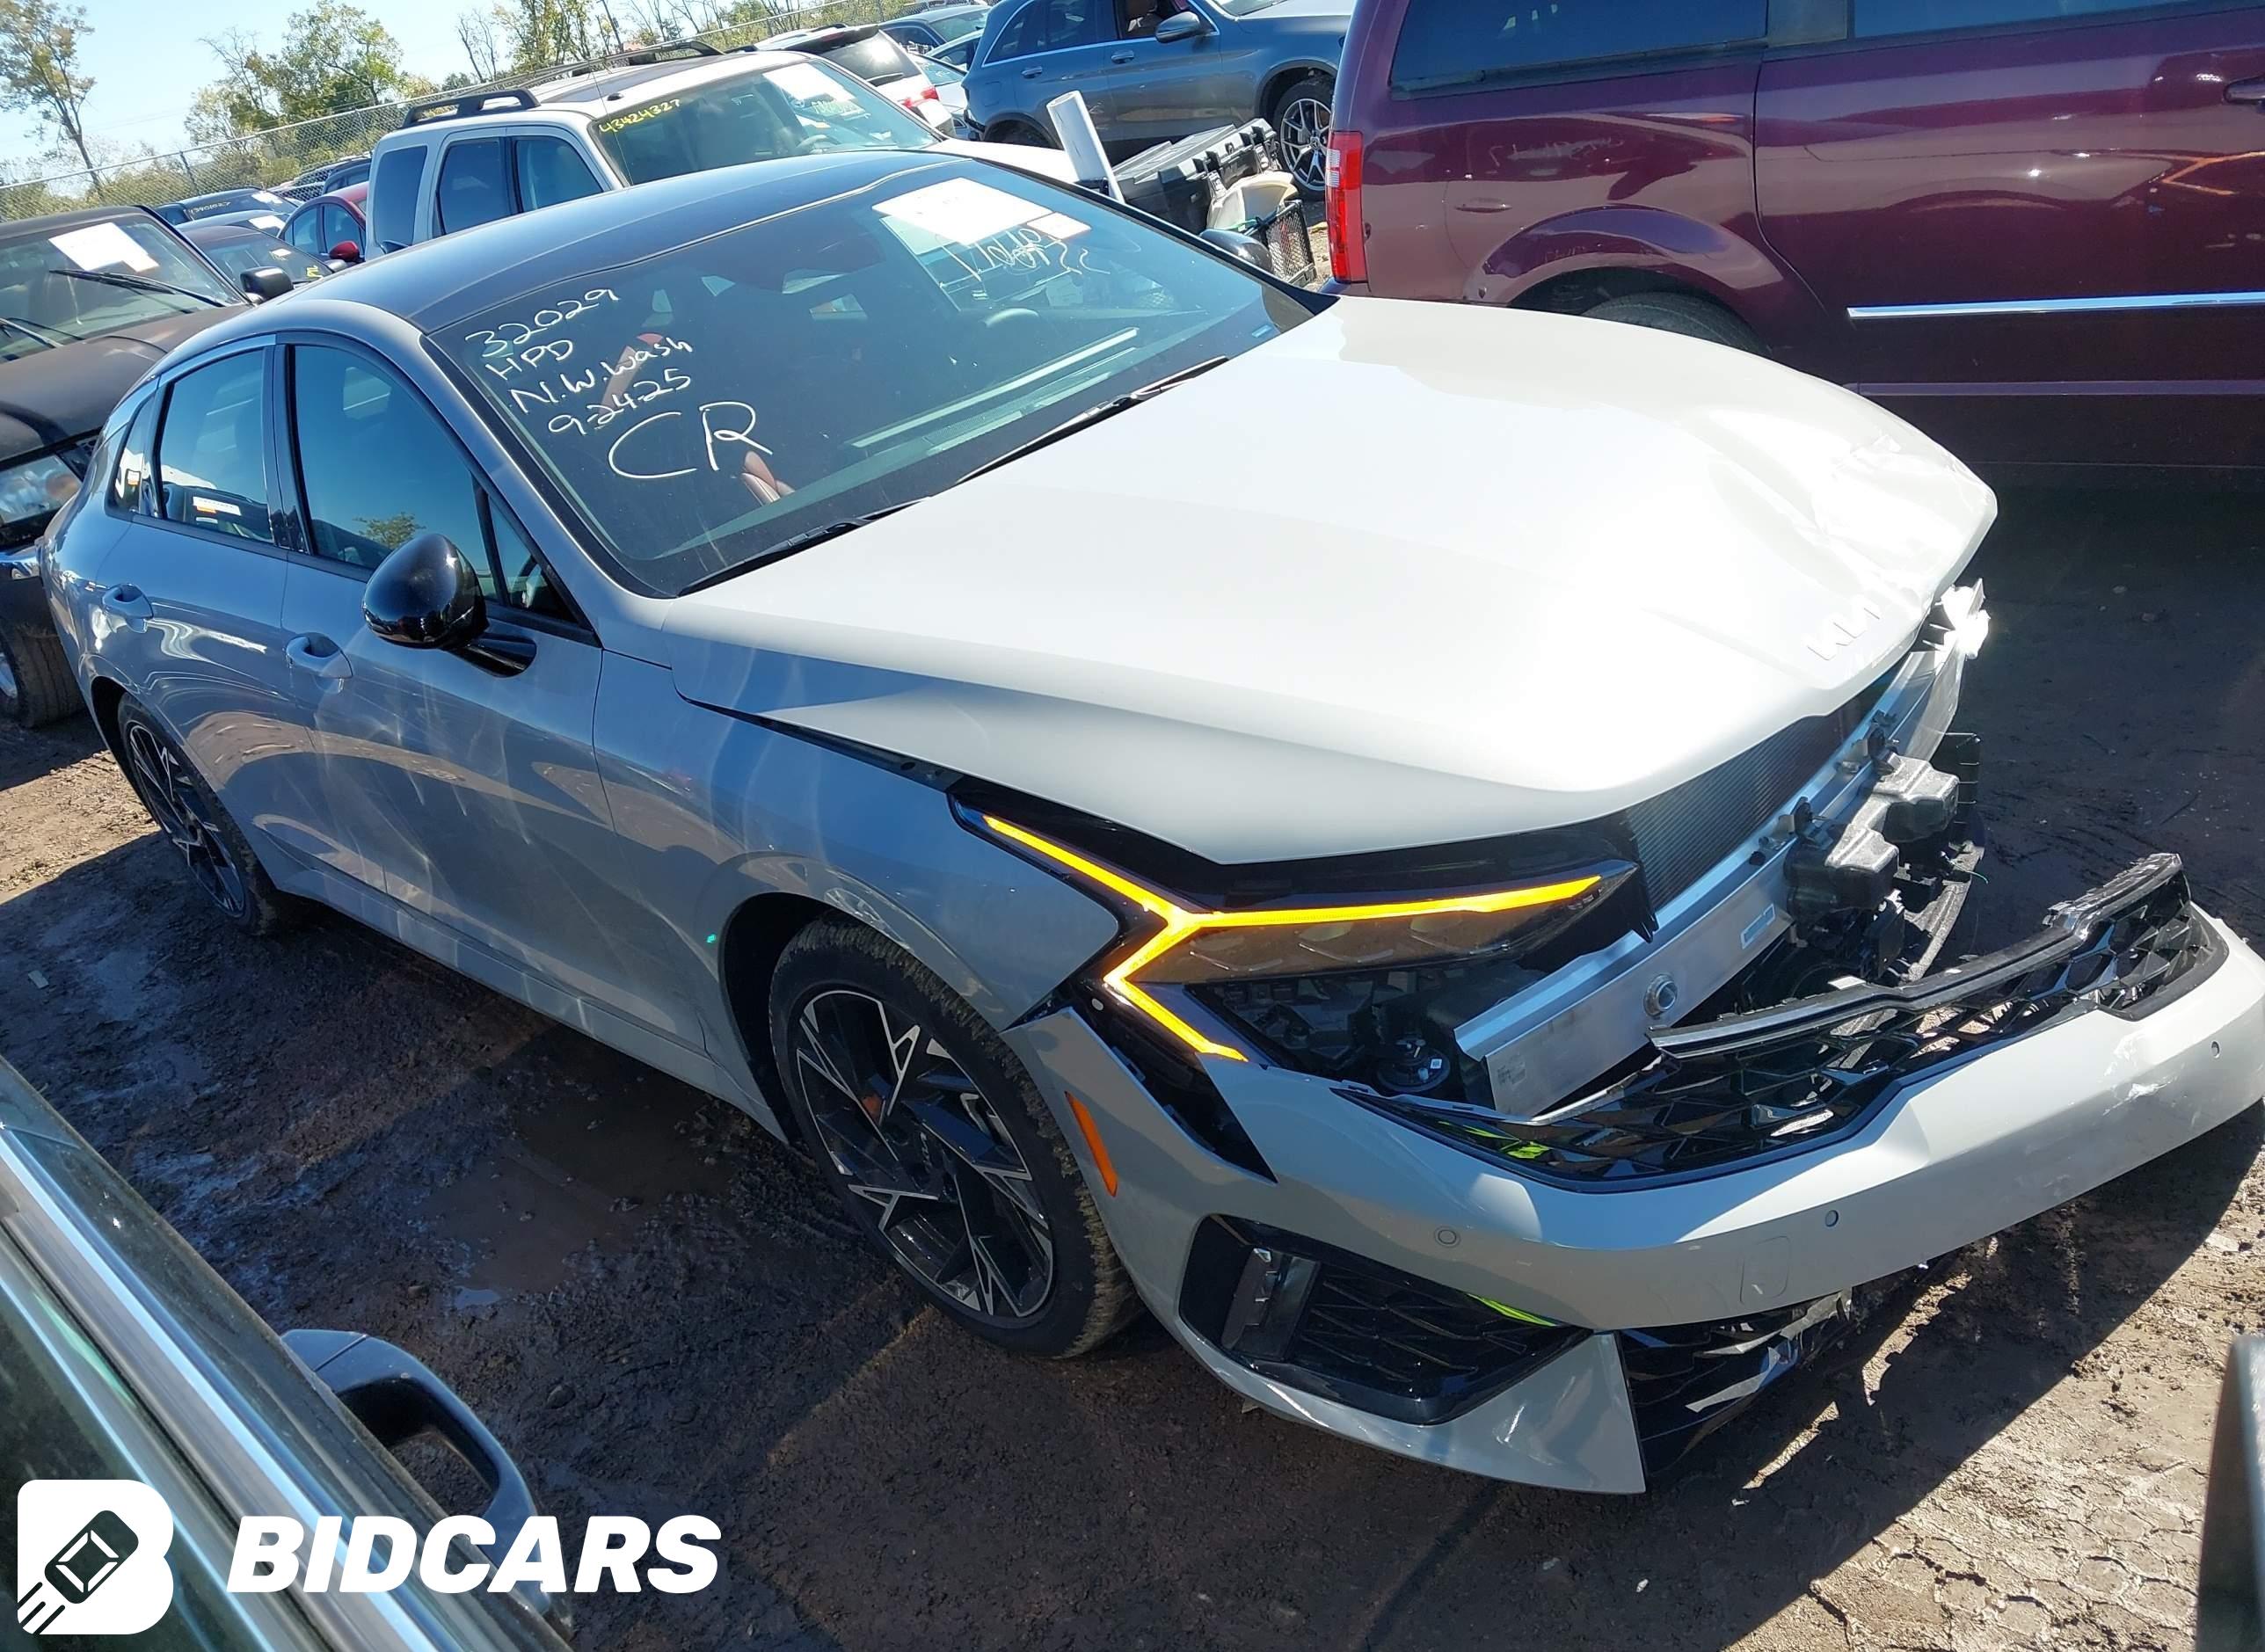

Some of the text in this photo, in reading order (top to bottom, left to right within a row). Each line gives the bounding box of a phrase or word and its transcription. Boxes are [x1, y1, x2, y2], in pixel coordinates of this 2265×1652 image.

[465, 288, 619, 357] 32029
[485, 339, 573, 381] HPD
[608, 401, 773, 478] CR
